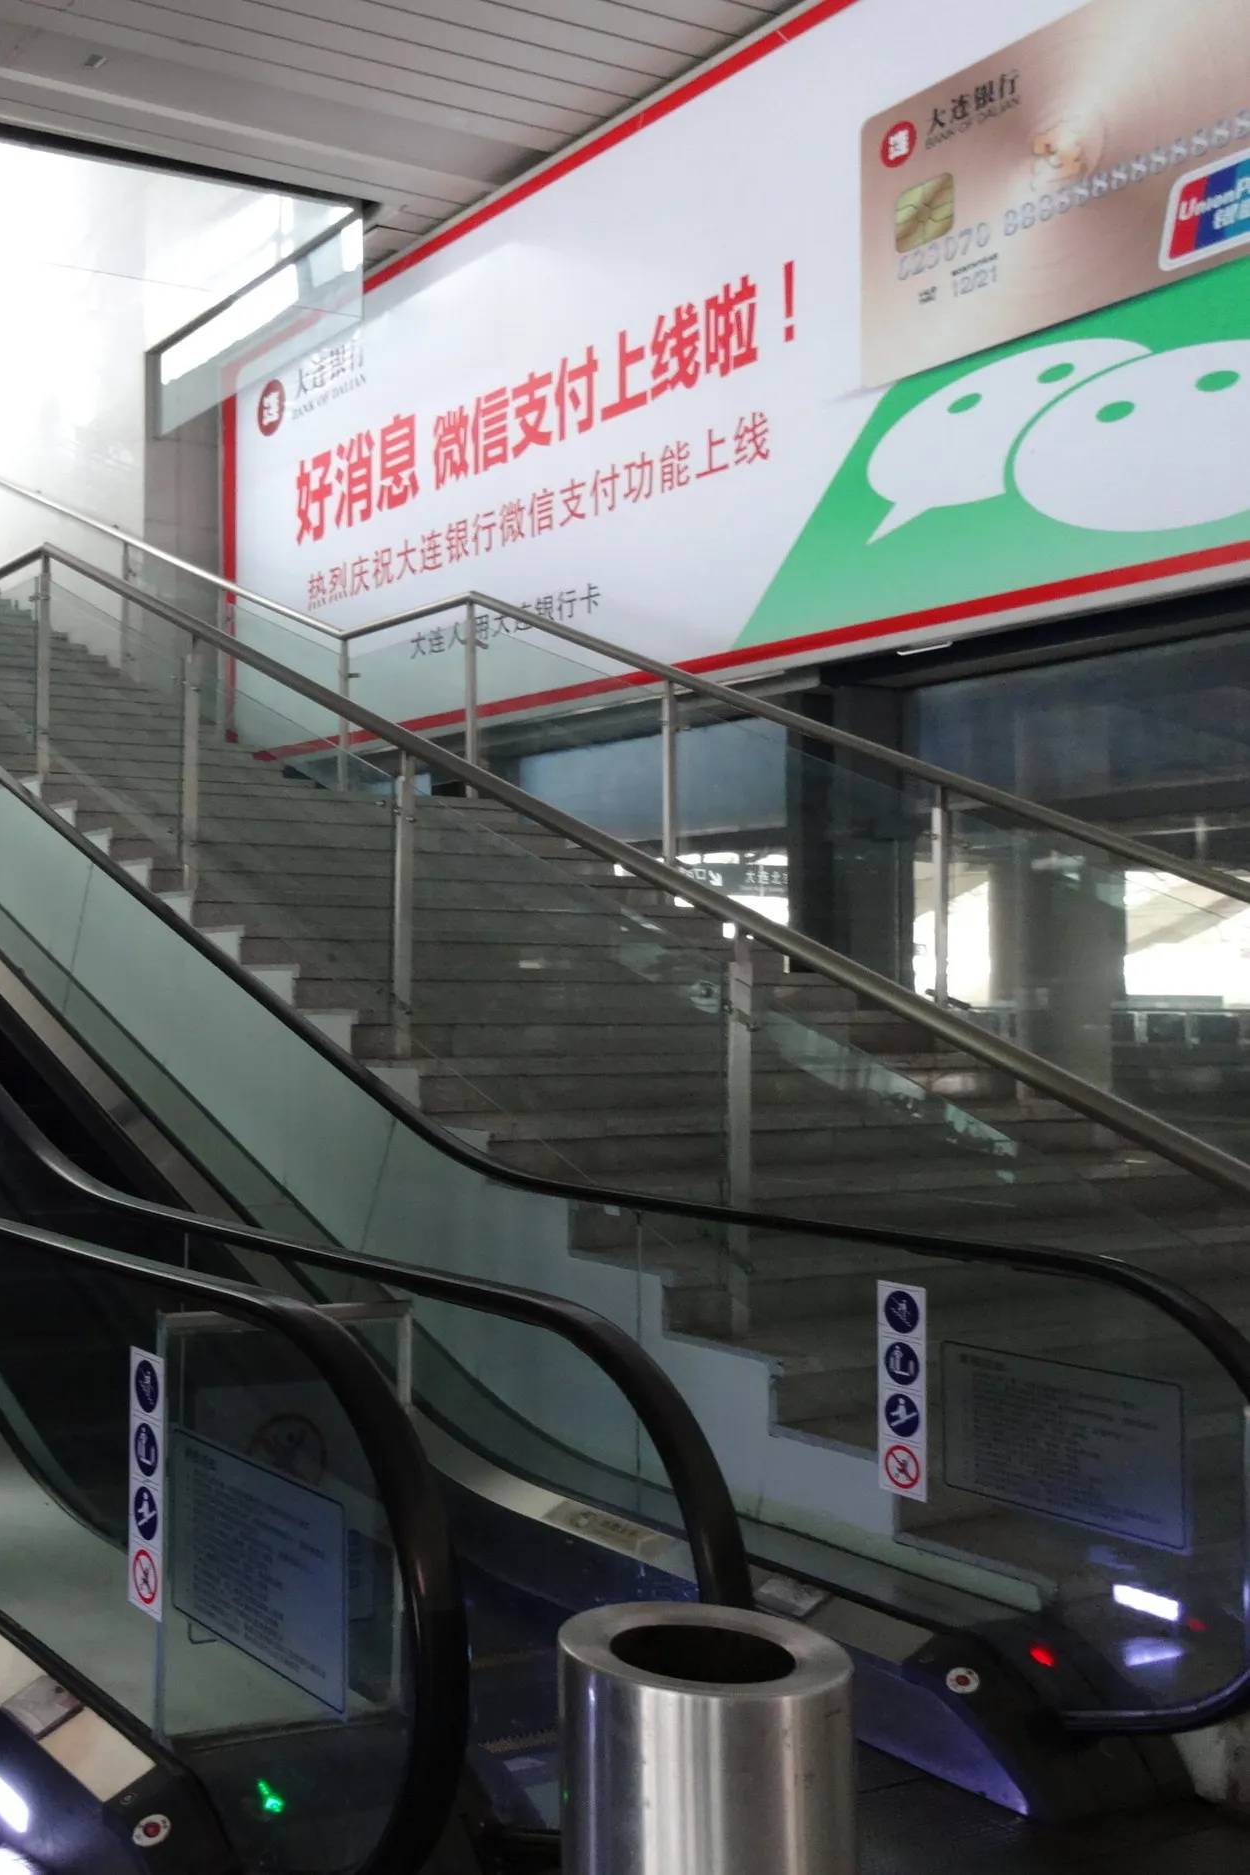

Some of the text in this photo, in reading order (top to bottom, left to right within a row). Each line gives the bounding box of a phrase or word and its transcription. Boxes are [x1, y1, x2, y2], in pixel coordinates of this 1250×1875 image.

[295, 413, 420, 546] 好消息
[307, 411, 770, 612] 热烈庆祝大连银行微信支付功能上线
